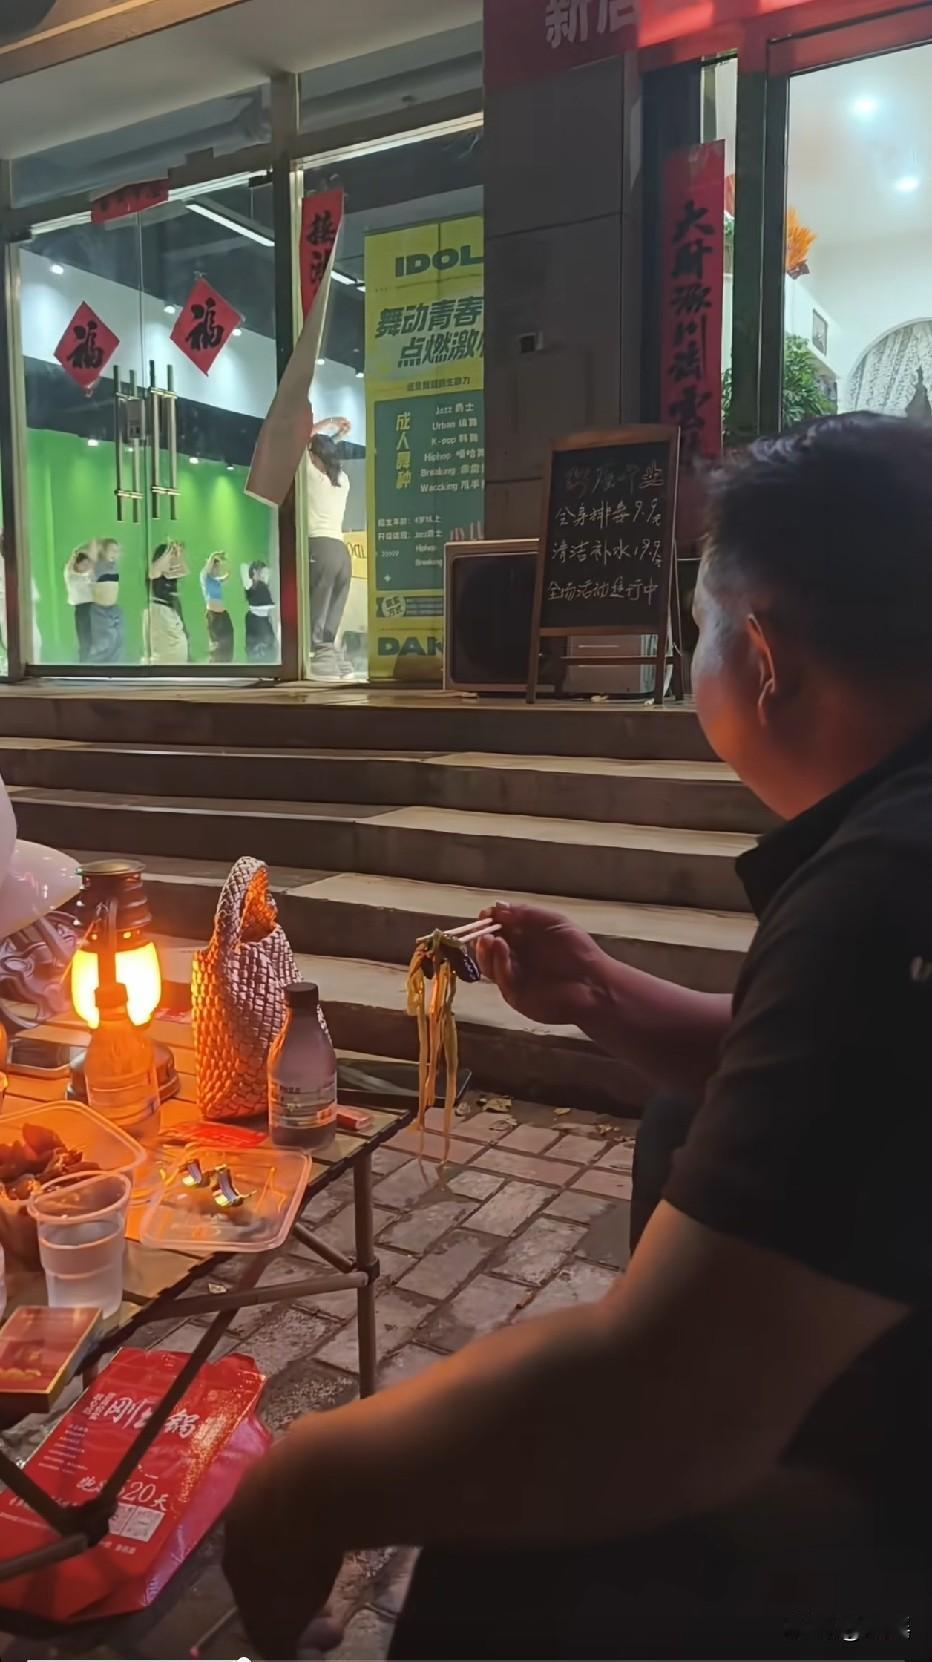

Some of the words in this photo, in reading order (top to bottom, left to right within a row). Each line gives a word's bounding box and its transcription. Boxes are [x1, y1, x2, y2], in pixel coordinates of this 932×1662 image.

[395, 244, 484, 278] IDOL
[185, 296, 225, 351] 福
[375, 296, 484, 339] 舞动青春
[66, 319, 105, 370] 福
